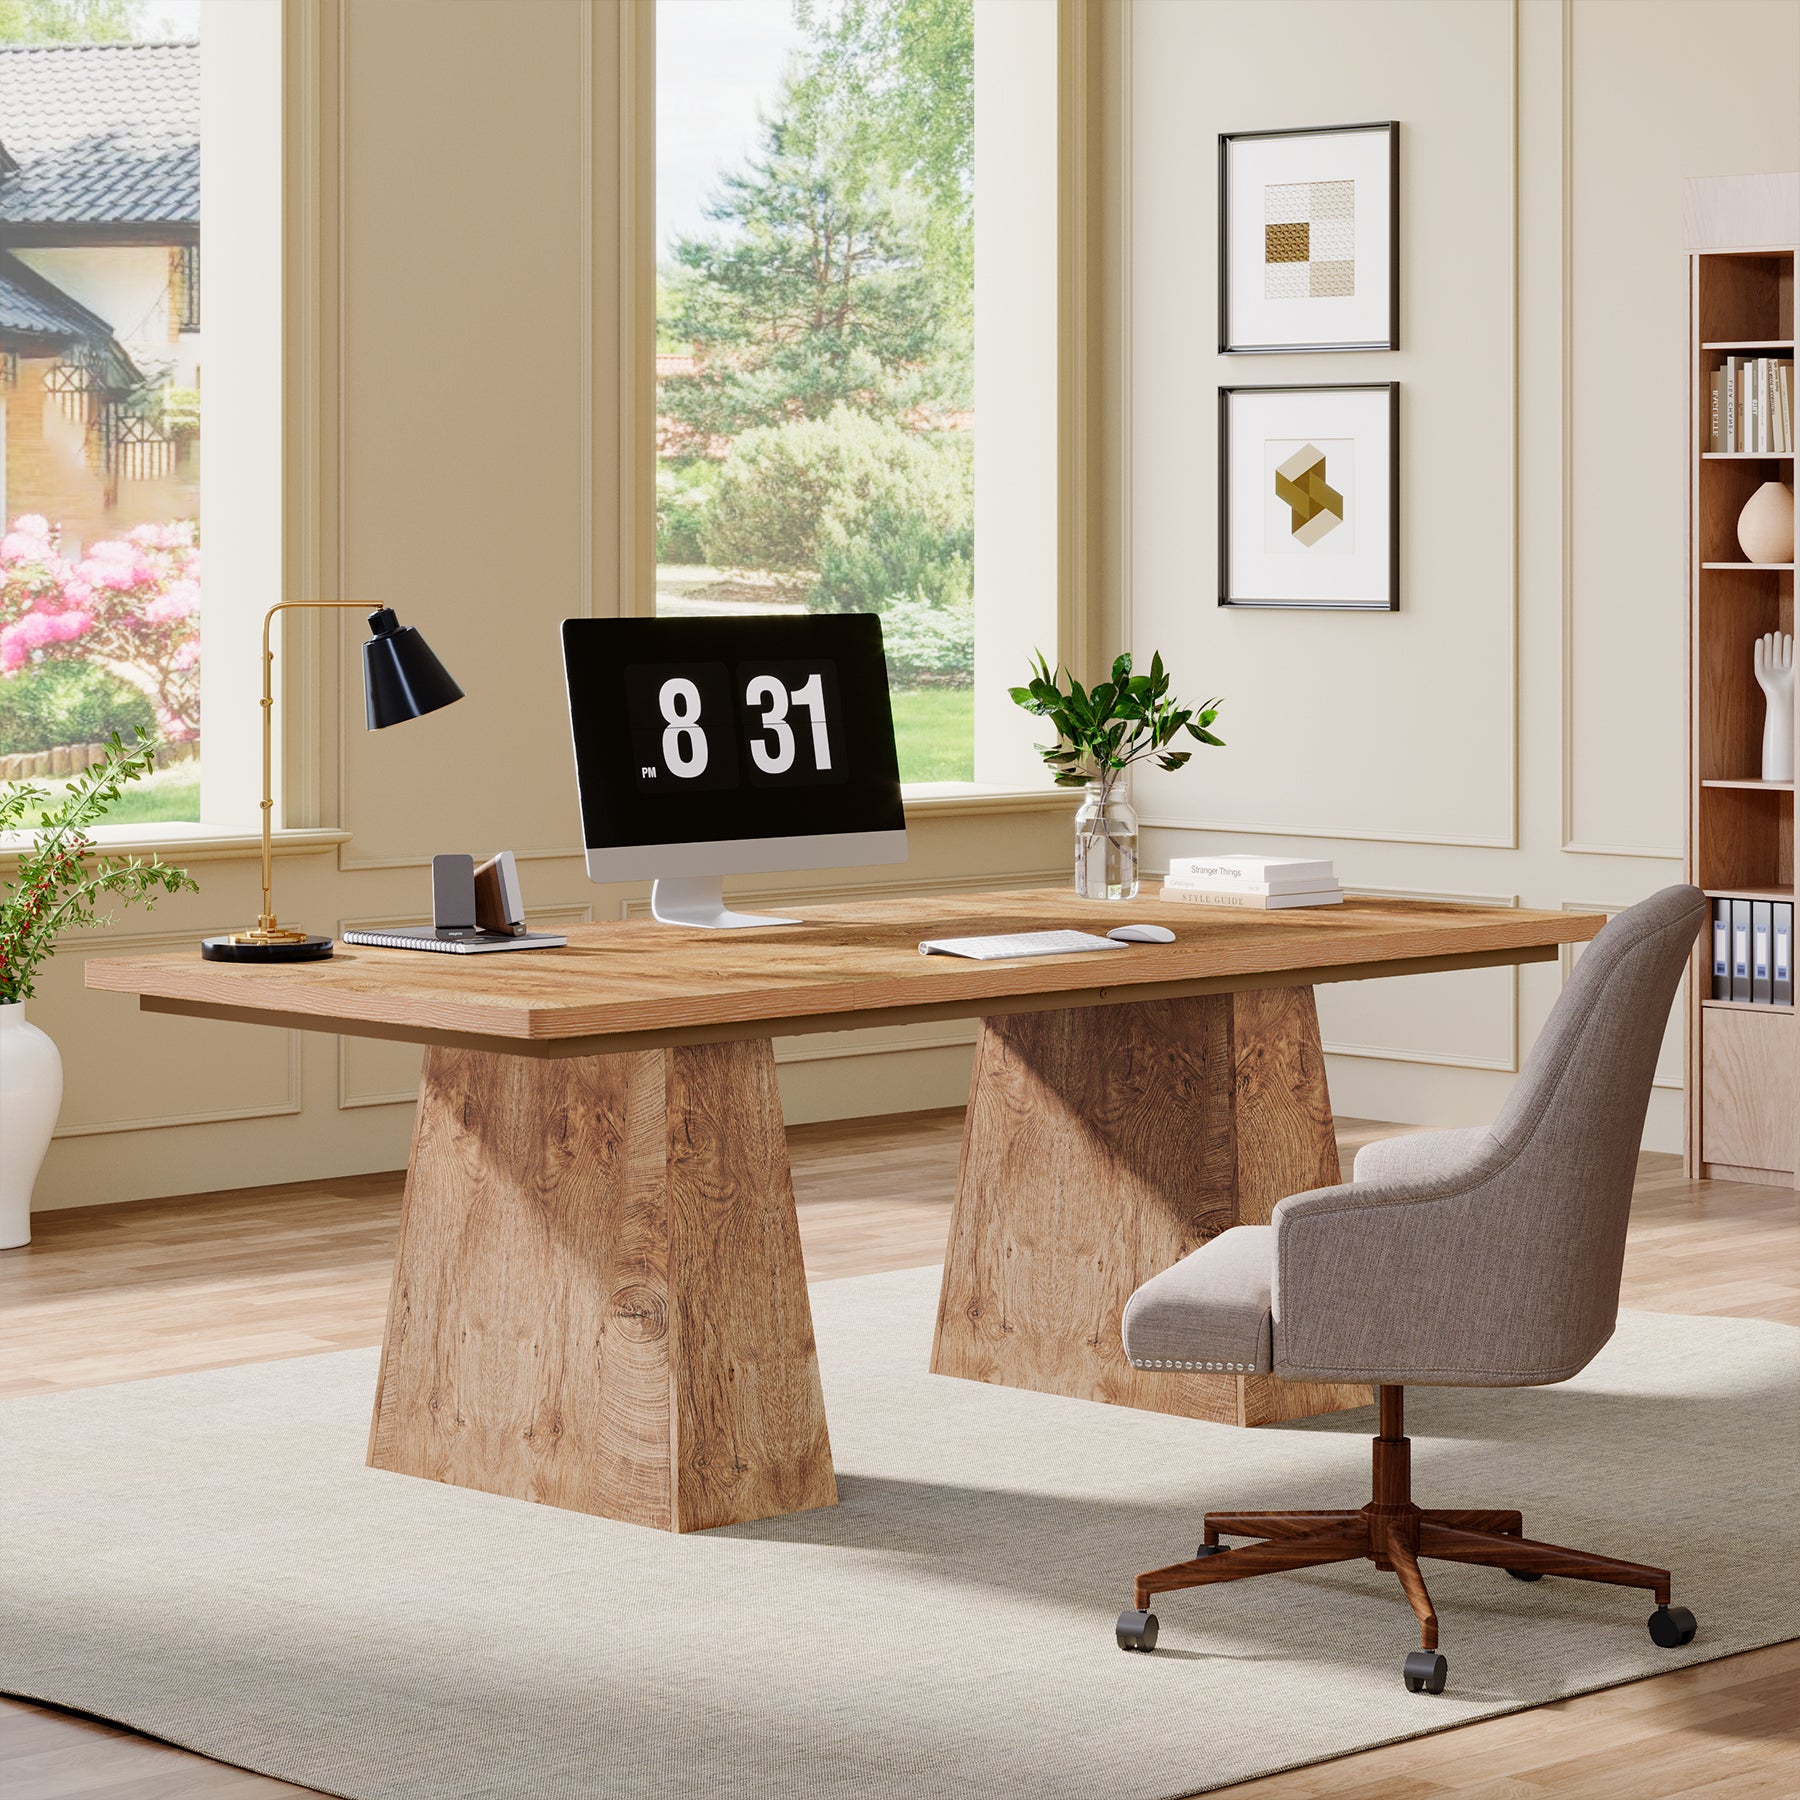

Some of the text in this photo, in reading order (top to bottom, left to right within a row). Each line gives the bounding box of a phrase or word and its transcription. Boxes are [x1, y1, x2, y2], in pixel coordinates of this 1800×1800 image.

[641, 673, 832, 779] PM 8 31
[1191, 864, 1242, 878] Stranger Things
[1182, 893, 1244, 906] STYLE GUIDE
